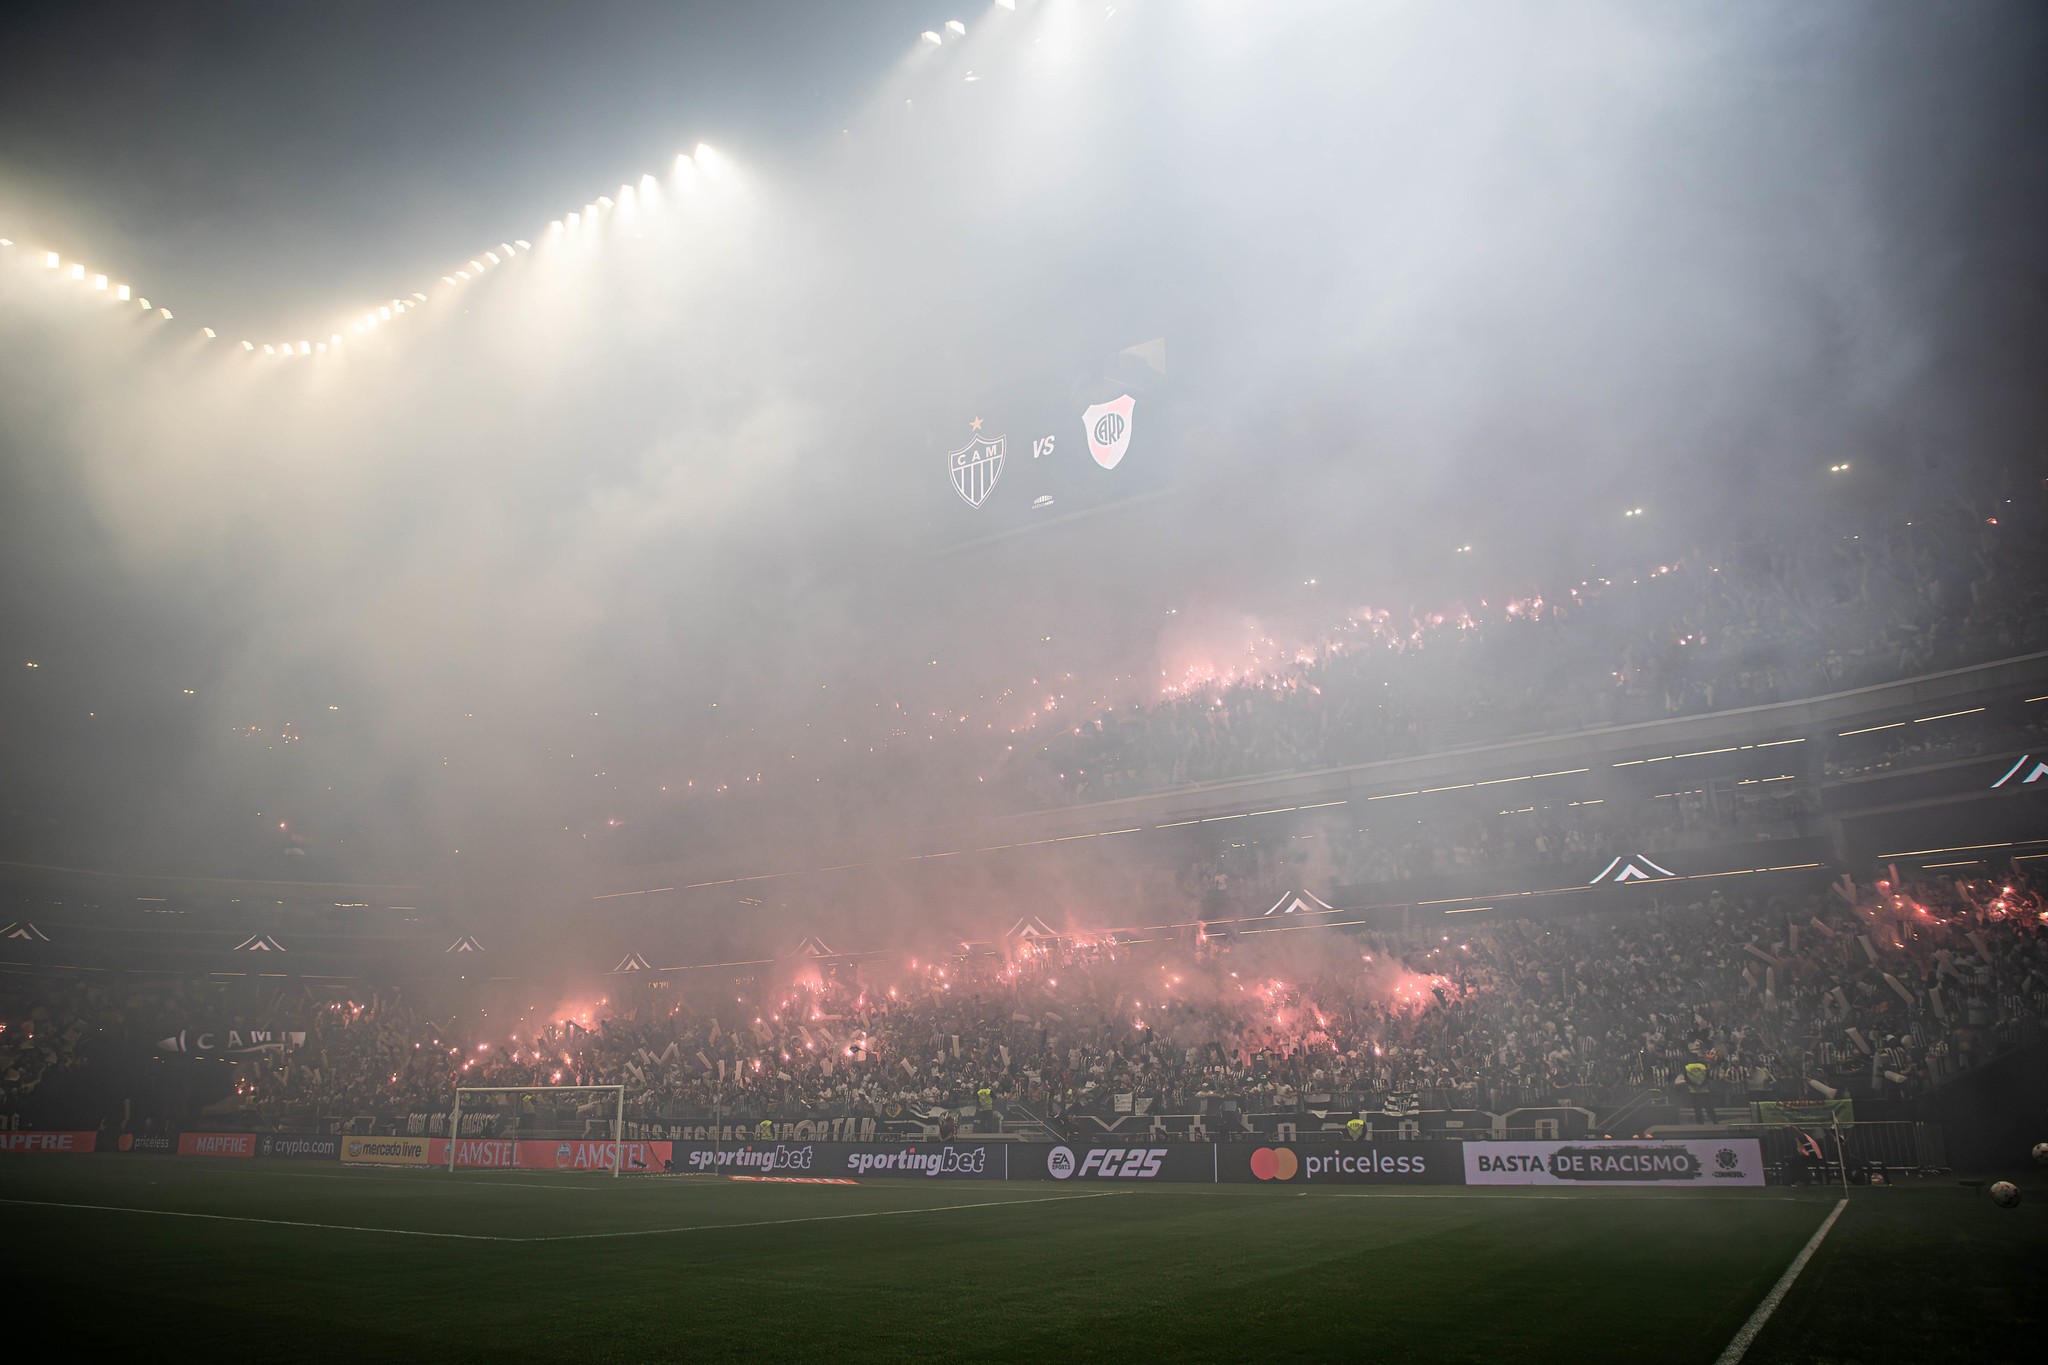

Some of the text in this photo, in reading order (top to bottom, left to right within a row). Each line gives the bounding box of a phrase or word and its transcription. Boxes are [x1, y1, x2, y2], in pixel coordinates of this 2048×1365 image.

[957, 444, 997, 465] CAM
[1032, 434, 1055, 459] VS
[134, 1133, 169, 1149] priceless
[196, 1136, 248, 1153] MAPFRE
[275, 1139, 334, 1155] crypto.com
[363, 1141, 422, 1157] mercado livre
[457, 1141, 520, 1165] AMSTEL
[574, 1143, 650, 1168] AMSTEL
[689, 1144, 812, 1172] sportingbet
[848, 1146, 985, 1176] sportingbet
[1053, 1153, 1070, 1164] EA
[1306, 1149, 1426, 1178] priceless
[1478, 1155, 1689, 1172] BASTA DE RACISMO
